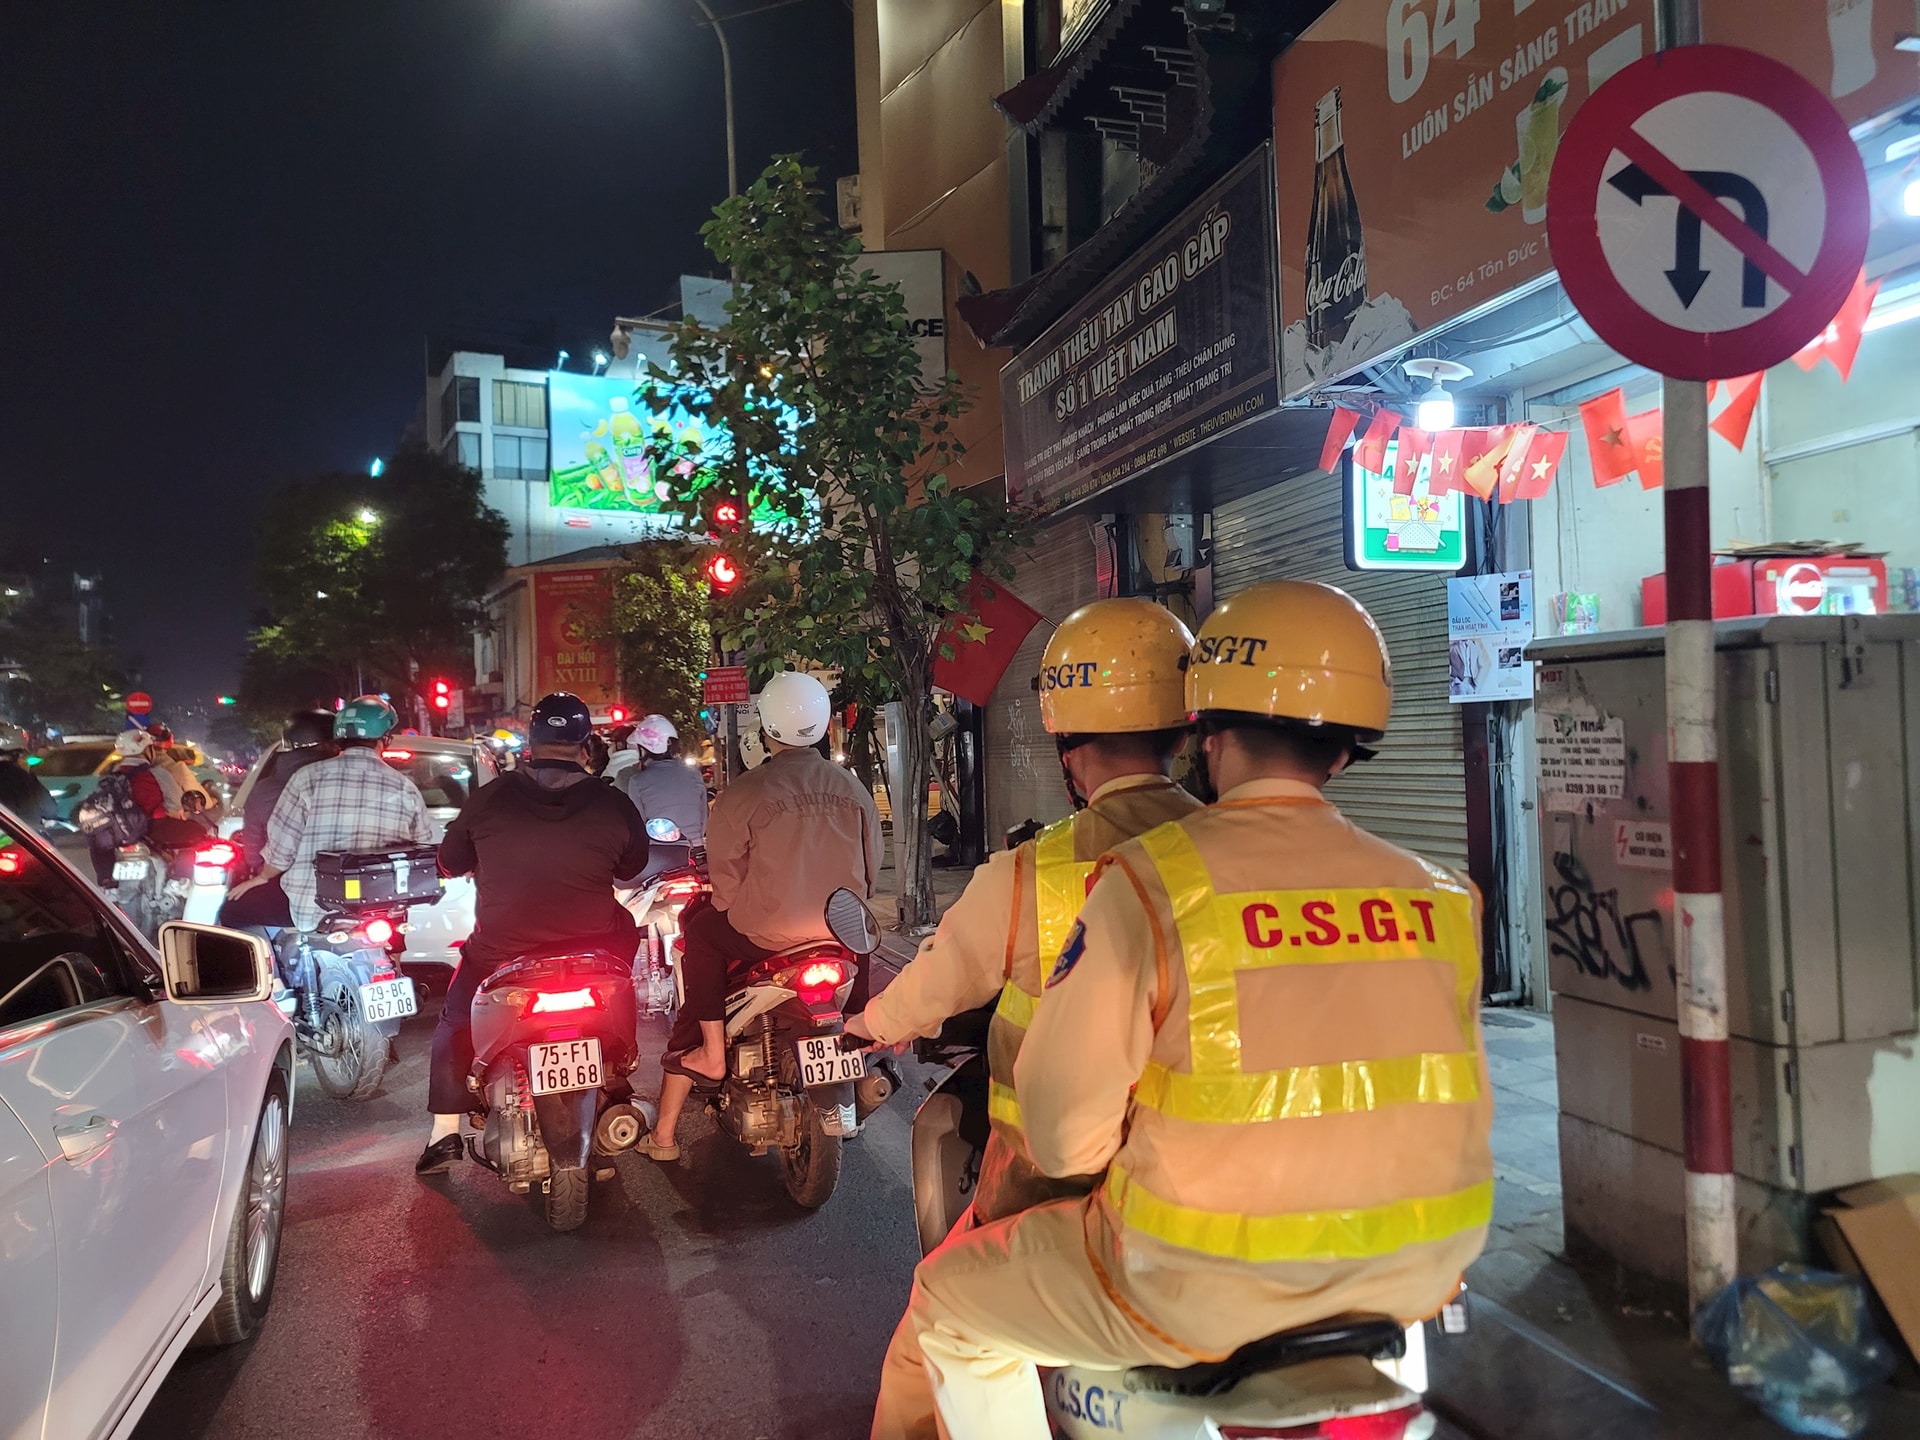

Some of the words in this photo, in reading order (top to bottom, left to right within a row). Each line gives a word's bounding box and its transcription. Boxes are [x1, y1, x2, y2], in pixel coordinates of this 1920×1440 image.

[1387, 0, 1480, 104] 64
[1402, 104, 1448, 159] LUÔN
[1499, 26, 1558, 91] SÀNG
[1306, 252, 1366, 316] Coca-Cola
[1430, 285, 1453, 307] ĐC:
[1456, 274, 1475, 293] 64
[1477, 256, 1504, 281] Tôn
[1507, 241, 1538, 267] Đức
[1018, 351, 1061, 403] TRANH
[1062, 320, 1101, 370] THÊU
[1102, 290, 1134, 340] TAY
[1139, 256, 1178, 313] CAO
[1183, 208, 1230, 278] CẤP
[1214, 333, 1236, 357] DUNG
[1056, 371, 1076, 419] SỐ
[1078, 375, 1088, 405] 1
[1090, 350, 1127, 393] VIỆT
[1130, 311, 1176, 370] NAM
[1195, 369, 1219, 392] TRANG
[1173, 428, 1196, 448] WEBSITE
[1189, 636, 1268, 667] CSGT
[554, 667, 598, 683] XVIII
[1039, 662, 1097, 691] CSGT
[1541, 670, 1563, 682] MBT
[1241, 898, 1436, 949] C.S.G.T
[368, 997, 413, 1020] 067.08
[539, 1041, 590, 1067] 75-F1
[537, 1064, 599, 1091] 168.68
[804, 1057, 862, 1084] 037.08
